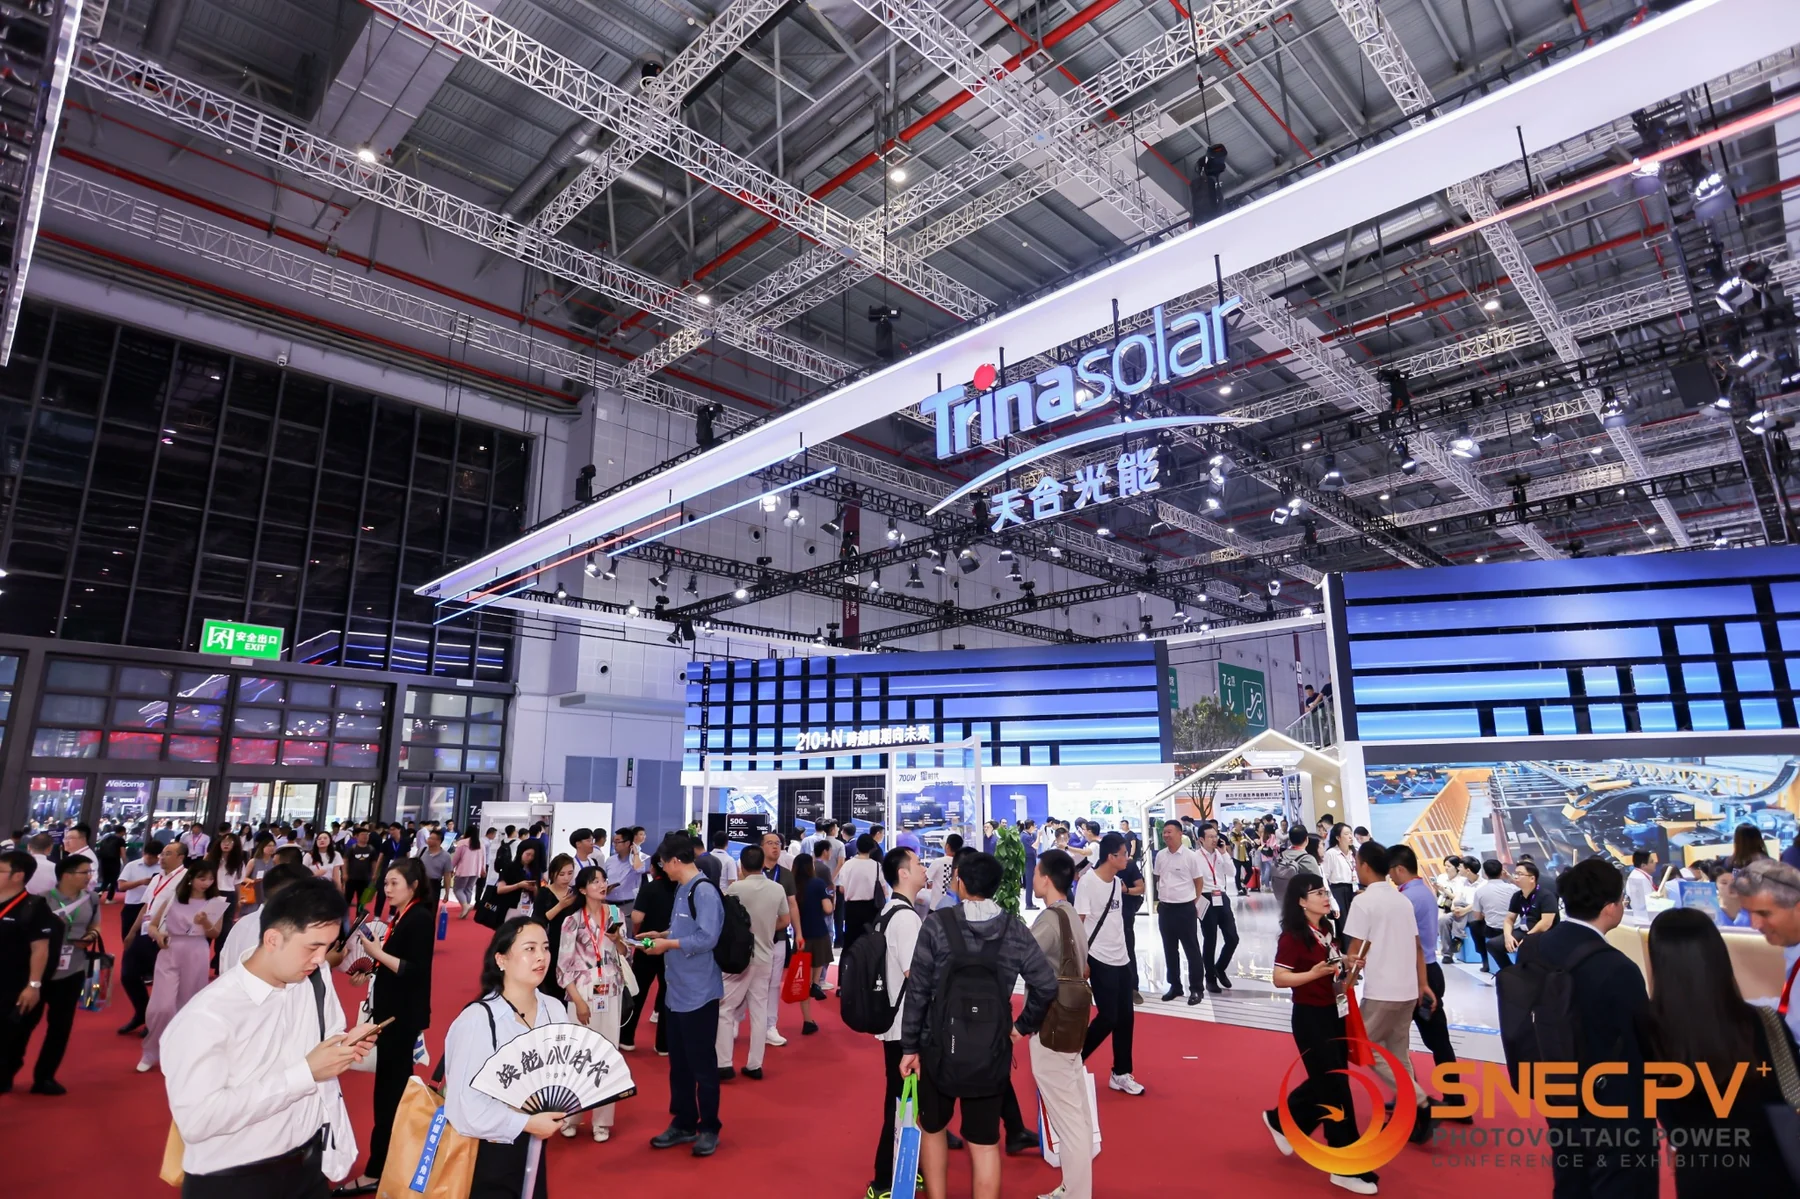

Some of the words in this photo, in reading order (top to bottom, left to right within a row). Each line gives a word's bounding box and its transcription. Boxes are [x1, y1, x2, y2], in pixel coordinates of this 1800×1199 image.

[920, 295, 1242, 460] Trinasolar
[990, 445, 1161, 533] 天合光能
[236, 631, 278, 645] 安全出口
[244, 643, 267, 652] EXIT
[795, 729, 843, 751] 210+N
[105, 780, 145, 788] Welcome
